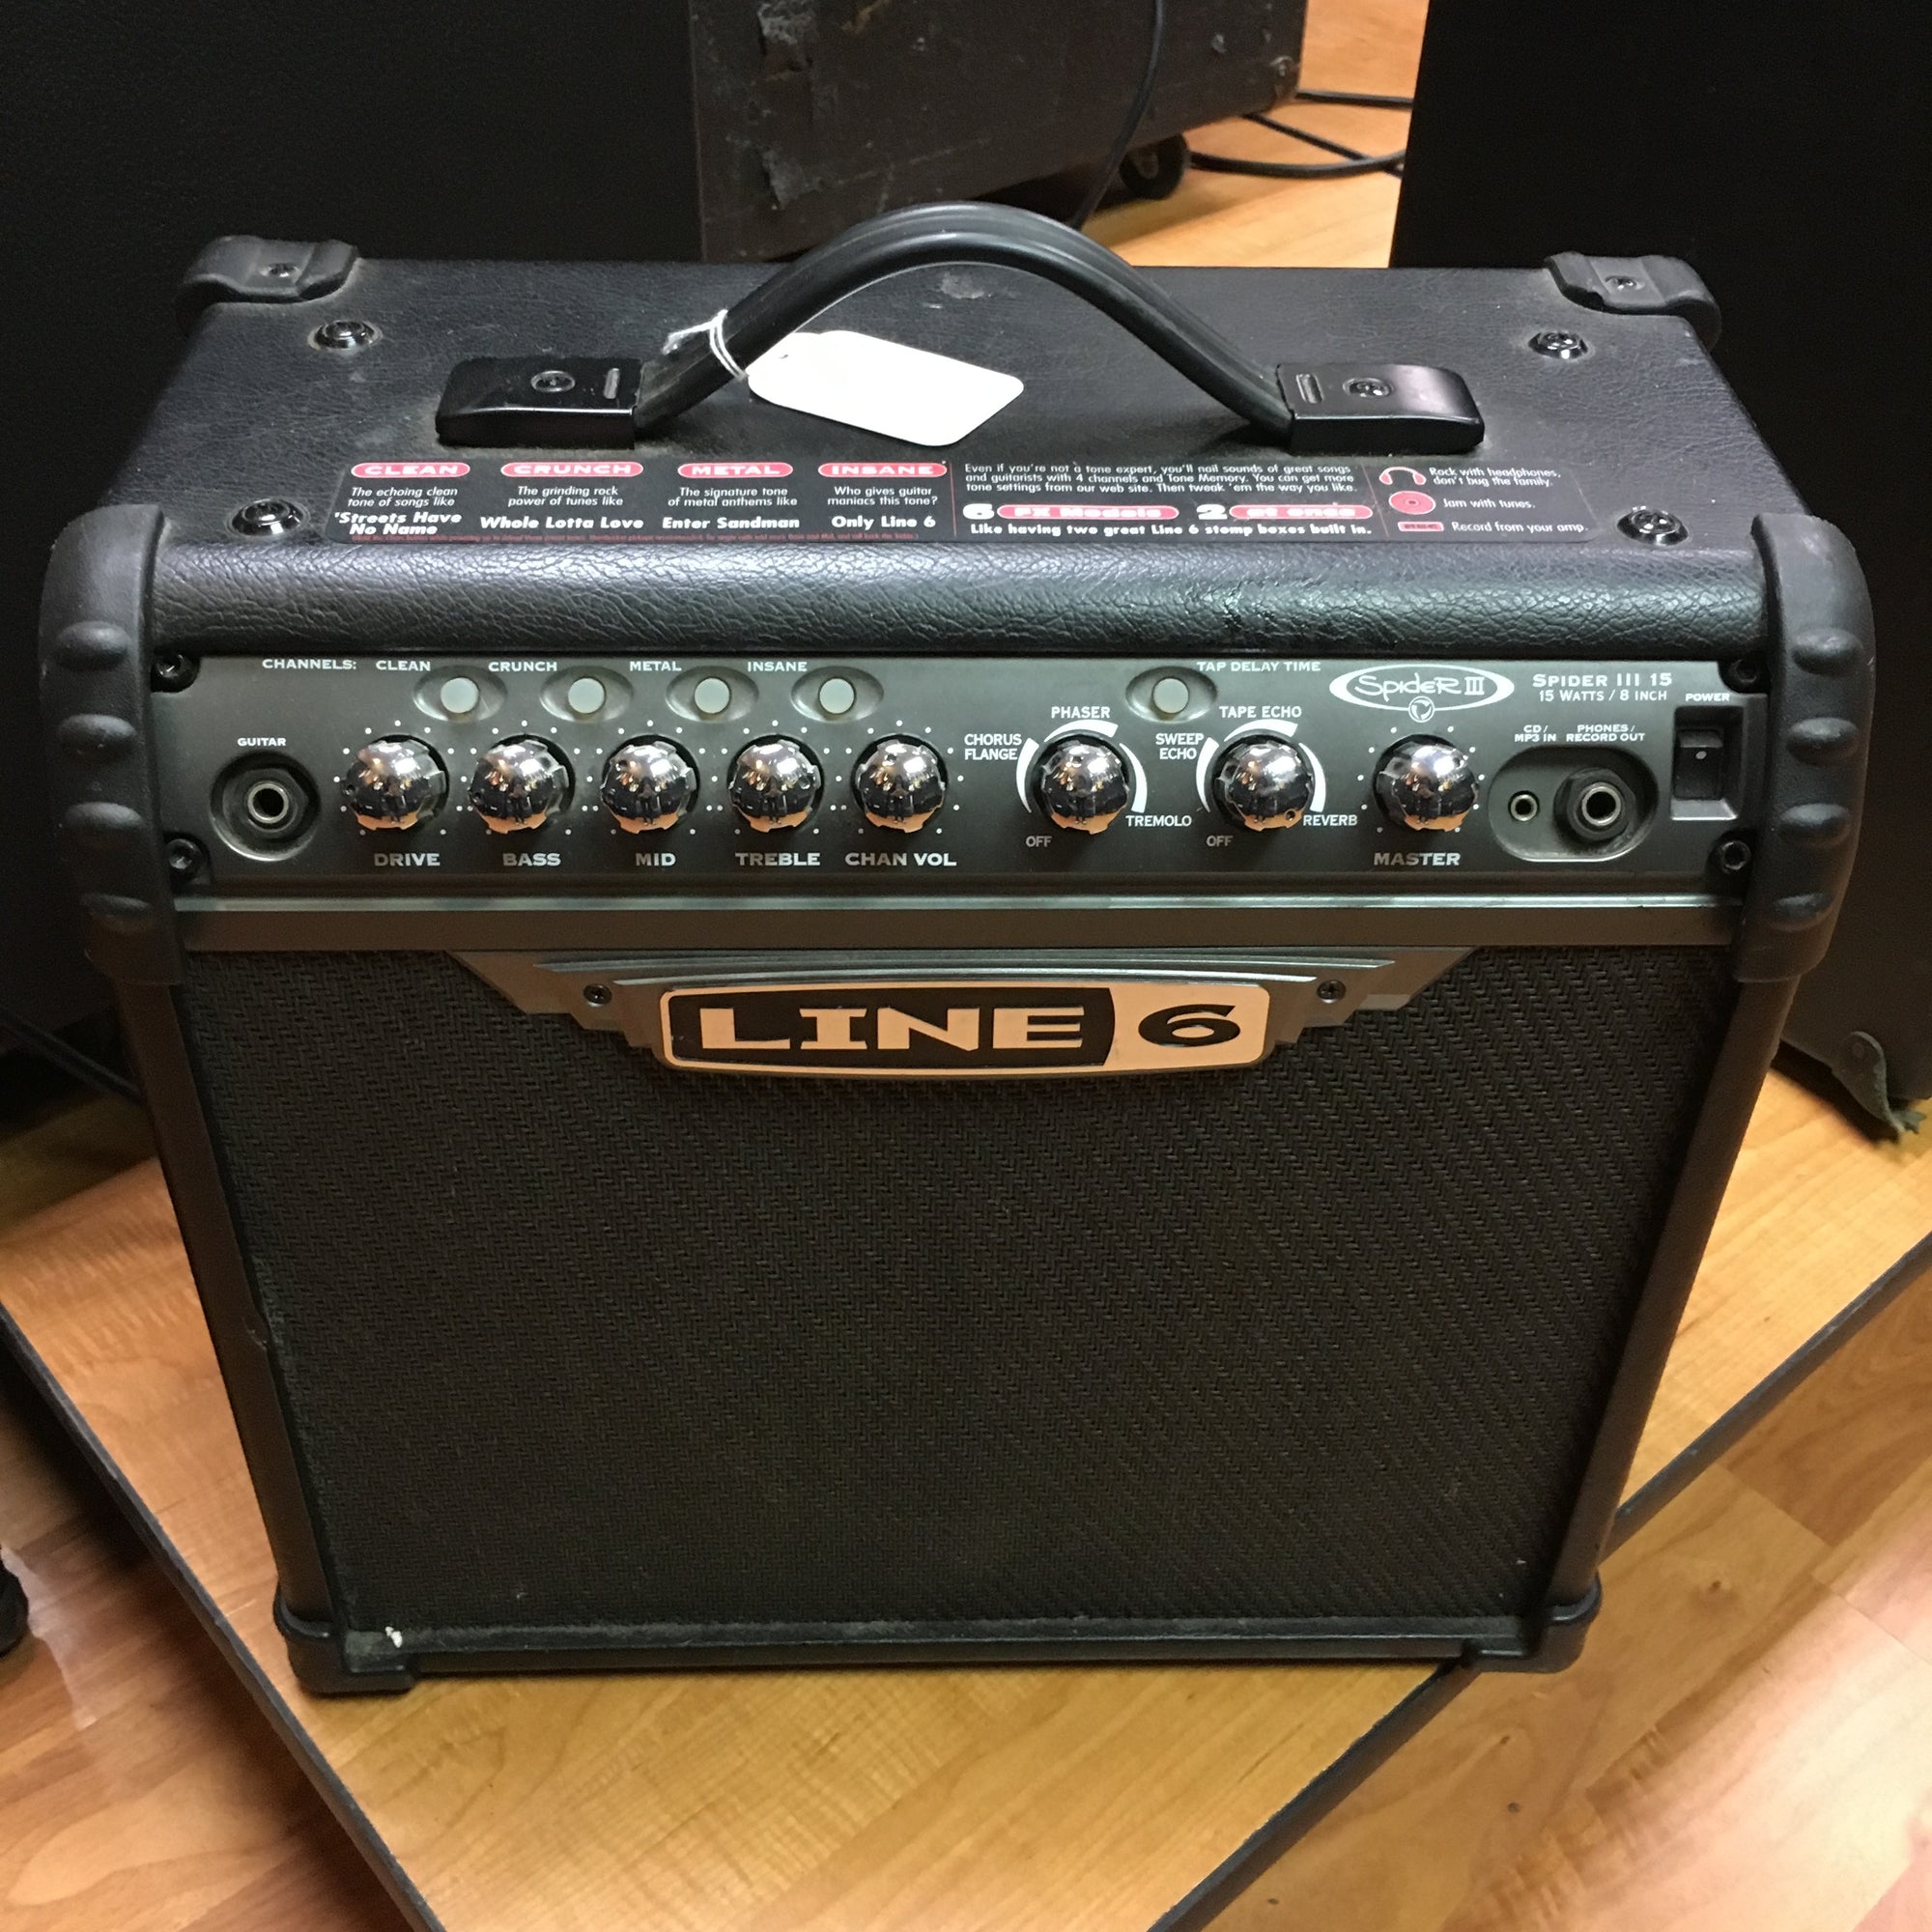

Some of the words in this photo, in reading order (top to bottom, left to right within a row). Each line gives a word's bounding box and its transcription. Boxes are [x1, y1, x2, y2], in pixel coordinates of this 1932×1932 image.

[364, 466, 459, 474] CLEAN
[514, 465, 631, 474] CRUNCH
[692, 466, 781, 475] METAL
[832, 466, 933, 475] INSANE
[965, 463, 992, 472] Even
[997, 463, 1005, 472] if
[1009, 464, 1046, 473] you're
[1116, 466, 1156, 474] expert,
[1161, 464, 1193, 474] you'll
[1198, 464, 1219, 473] nail
[1223, 464, 1264, 473] sounds
[1267, 464, 1278, 473] of
[1283, 466, 1313, 474] great
[1318, 466, 1350, 474] songs
[1429, 468, 1457, 477] Rock
[1460, 468, 1485, 477] with
[966, 472, 987, 482] and
[991, 473, 1043, 483] guitarists
[1046, 473, 1071, 482] with
[1076, 473, 1083, 482] 4
[1089, 474, 1138, 483] channels
[1142, 474, 1163, 483] and
[1168, 474, 1194, 483] Tone
[1252, 473, 1274, 482] You
[1302, 474, 1321, 483] get
[1467, 477, 1490, 487] bug
[1492, 477, 1511, 486] the
[352, 487, 373, 497] The
[376, 487, 423, 498] echoing
[427, 486, 458, 497] clean
[518, 486, 538, 496] The
[542, 486, 589, 497] grinding
[593, 486, 618, 496] rock
[679, 487, 700, 497] The
[704, 488, 758, 498] signature
[834, 486, 862, 496] Who
[865, 487, 895, 497] gives
[898, 487, 932, 497] guitar
[966, 483, 992, 492] tone
[997, 483, 1041, 494] settings
[1045, 482, 1072, 492] from
[1099, 483, 1124, 493] web
[1128, 484, 1152, 493] site.
[1155, 483, 1185, 492] Then
[1189, 483, 1224, 492] tweak
[1256, 483, 1275, 492] the
[1278, 484, 1303, 494] way
[1307, 484, 1328, 494] you
[348, 498, 375, 507] tone
[379, 497, 392, 507] of
[394, 498, 429, 508] songs
[433, 497, 455, 506] like
[508, 497, 546, 507] power
[550, 496, 561, 506] of
[566, 497, 598, 506] tunes
[602, 496, 624, 505] like
[668, 497, 680, 507] of
[684, 497, 718, 507] metal
[722, 497, 773, 507] anthems
[777, 497, 798, 506] like
[827, 497, 875, 505] maniacs
[879, 496, 900, 505] this
[904, 496, 938, 505] tone?
[1443, 498, 1466, 508] Jam
[1470, 499, 1496, 508] with
[1499, 499, 1536, 509] tunes.
[962, 503, 995, 520] 6
[1196, 503, 1228, 520] 2
[412, 512, 462, 524] Have
[480, 516, 540, 529] Whole
[545, 517, 594, 529] Lotta
[600, 517, 644, 529] Love
[662, 517, 711, 528] Enter
[717, 516, 800, 528] Sandman
[831, 515, 874, 531] Only
[881, 515, 918, 527] Line
[923, 515, 936, 527] 6
[349, 524, 377, 534] No
[383, 524, 438, 534] Name
[971, 523, 1003, 534] Like
[1008, 523, 1062, 537] having
[1066, 525, 1098, 534] two
[1103, 526, 1146, 537] great
[1151, 525, 1183, 534] Line
[1188, 525, 1199, 534] 6
[1205, 526, 1253, 536] stomp
[1258, 524, 1305, 534] boxes
[1310, 524, 1346, 534] built
[1350, 524, 1372, 534] in.
[1452, 522, 1492, 531] Record
[1494, 522, 1523, 531] from
[1527, 524, 1552, 533] your
[262, 659, 356, 669] CHANNELS:
[376, 660, 431, 671] CLEAN
[488, 662, 557, 672] CRUNCH
[630, 661, 682, 671] METAL
[748, 662, 808, 672] INSANE
[1197, 662, 1227, 671] TAP
[1231, 662, 1280, 671] DELAY
[1283, 662, 1321, 671] TIME
[1650, 672, 1673, 686] 15
[1539, 690, 1554, 702] 15
[1608, 690, 1615, 701] /
[1619, 690, 1629, 701] 8
[1634, 691, 1667, 701] INCH
[1685, 693, 1731, 702] POWER
[1051, 706, 1111, 719] PHASER
[1219, 706, 1257, 718] TAPE
[1262, 706, 1302, 718] ECHO
[237, 737, 287, 747] GUITAR
[964, 733, 1022, 746] CHORUS
[1155, 732, 1205, 746] SWEEP
[1515, 734, 1540, 743] MP3
[1566, 733, 1617, 742] RECORD
[964, 749, 1018, 760] FLANGE
[1159, 748, 1197, 760] ECHO
[1125, 815, 1192, 827] TREMOLO
[1303, 814, 1358, 826] REVERB
[1026, 836, 1052, 847] OFF
[1206, 835, 1234, 847] OFF
[374, 853, 440, 867] DRIVE
[502, 853, 561, 867] BASS
[636, 853, 676, 867] MID
[735, 853, 821, 867] TREBLE
[845, 853, 907, 867] CHAN
[913, 853, 957, 867] VOL
[1374, 852, 1462, 867] MASTER
[699, 1007, 1086, 1052] LINE
[1138, 1004, 1241, 1048] 6
